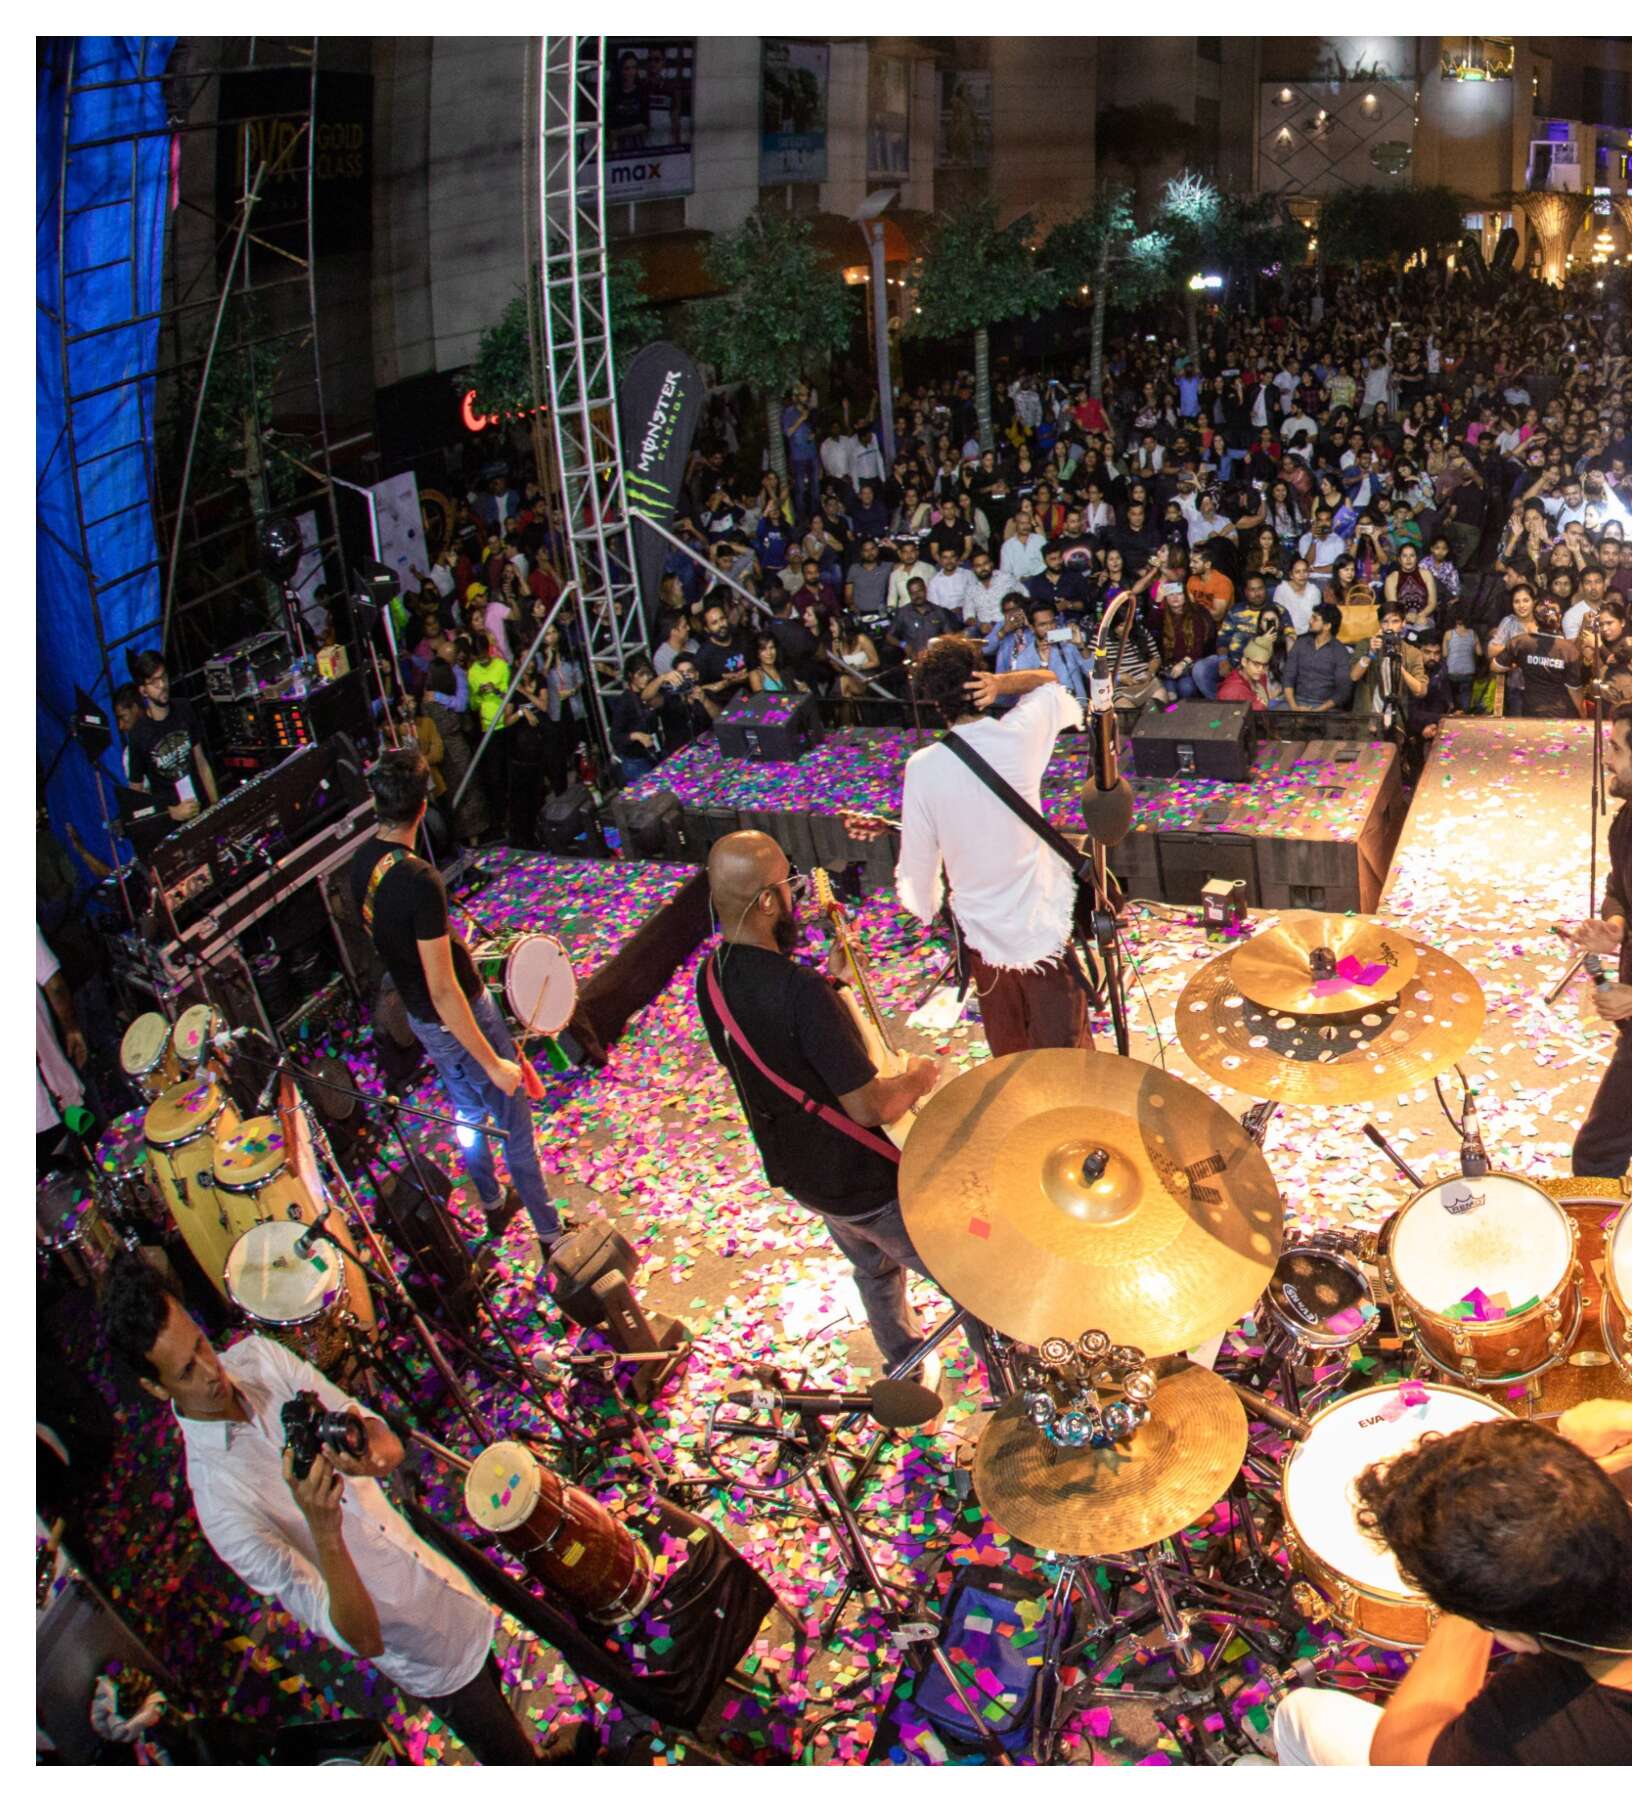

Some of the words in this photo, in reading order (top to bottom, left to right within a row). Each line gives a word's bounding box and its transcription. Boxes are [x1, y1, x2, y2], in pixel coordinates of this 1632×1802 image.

[318, 123, 364, 148] GOLD
[318, 153, 363, 178] CLASS
[611, 160, 662, 184] max
[638, 370, 682, 472] MONSTER
[657, 390, 686, 461] ENERGY
[1527, 654, 1566, 670] BOUNCER
[1286, 1288, 1315, 1321] EVANS
